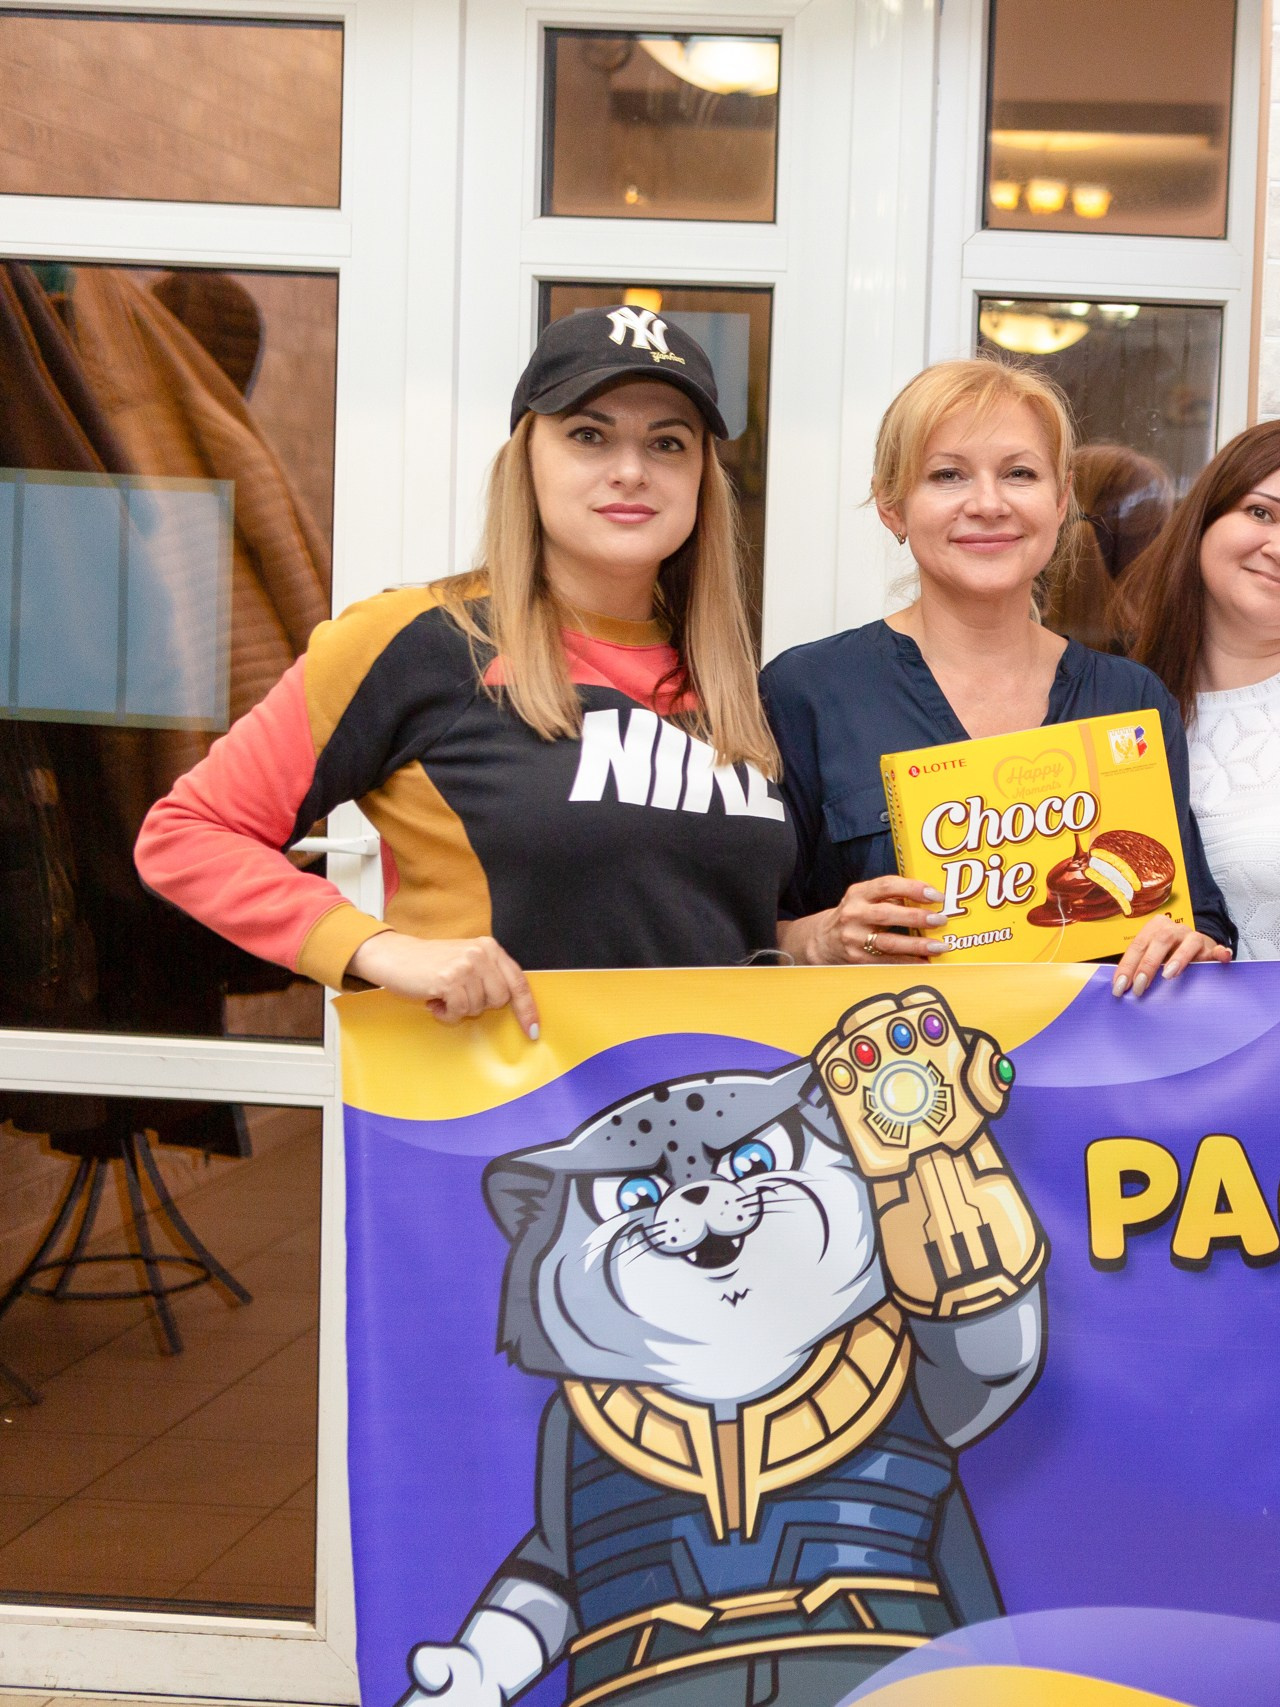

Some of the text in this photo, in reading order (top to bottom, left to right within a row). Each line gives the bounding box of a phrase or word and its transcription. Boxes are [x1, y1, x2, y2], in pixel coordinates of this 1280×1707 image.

[923, 758, 967, 773] LOTTE
[1006, 763, 1064, 785] Happy
[1012, 781, 1062, 799] Moments
[921, 791, 1099, 857] Choco
[939, 854, 1036, 917] Pie
[943, 927, 1013, 952] Banana
